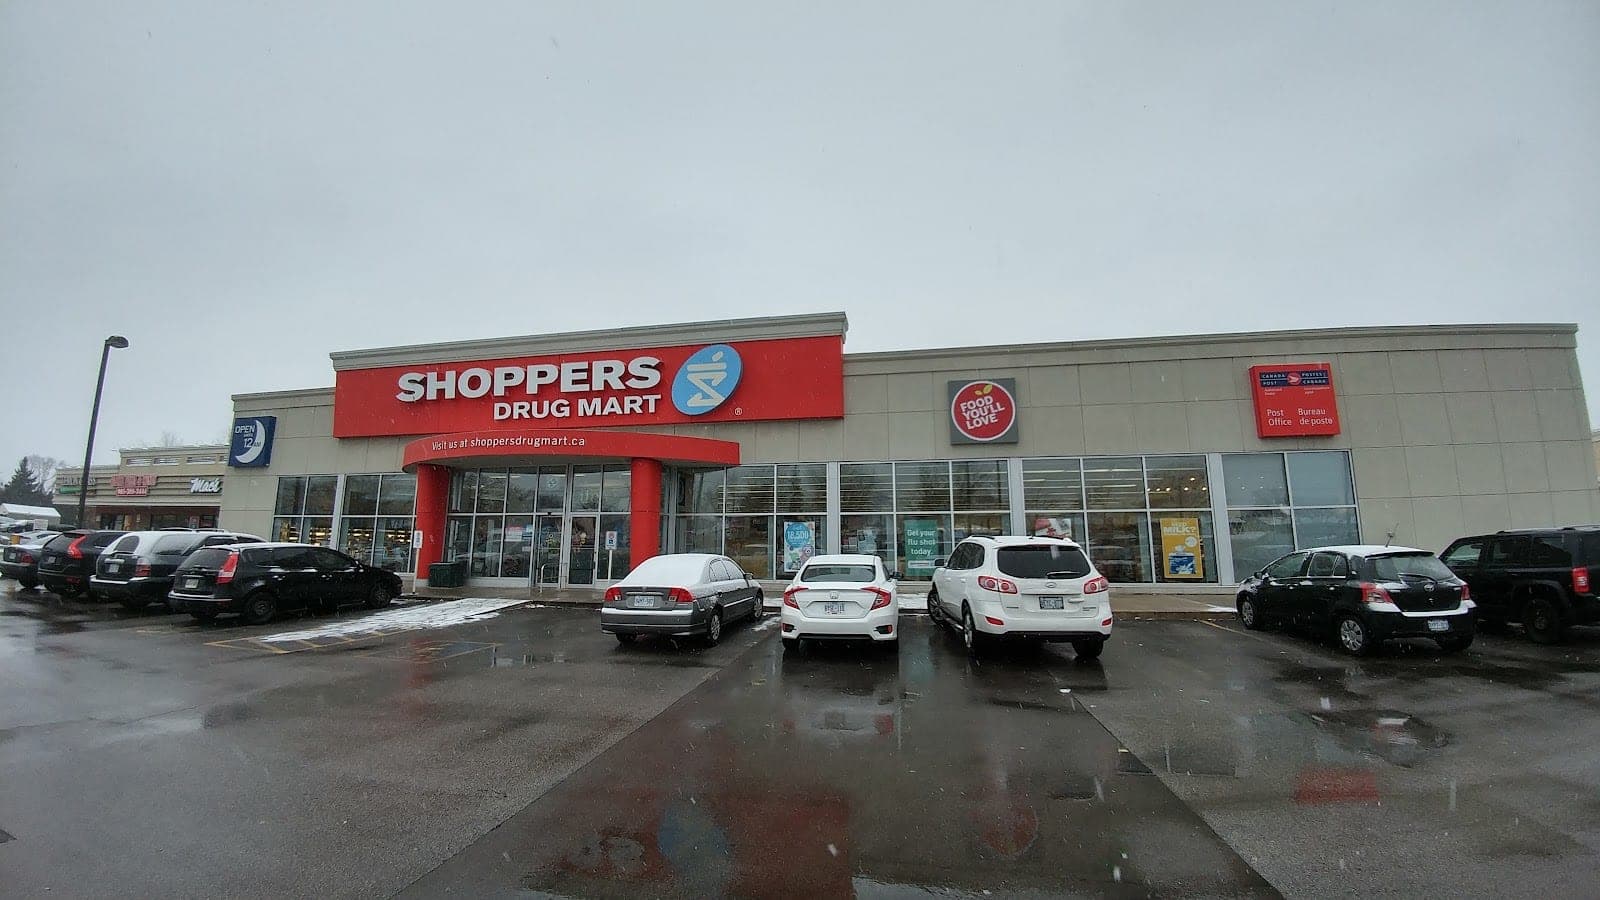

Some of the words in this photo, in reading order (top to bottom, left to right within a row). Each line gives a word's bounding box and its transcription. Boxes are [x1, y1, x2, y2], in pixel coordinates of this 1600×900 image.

[396, 356, 661, 402] SHOPPERS
[493, 398, 570, 420] DRUG
[577, 394, 661, 418] MART
[960, 395, 993, 412] FOOD
[961, 402, 1005, 420] YOU'LL
[1266, 409, 1284, 417] Post
[1297, 408, 1326, 416] Bureau
[966, 413, 999, 430] LOVE
[1268, 418, 1292, 426] Office
[1311, 417, 1333, 426] poste
[234, 425, 255, 434] OPEN
[432, 441, 447, 450] Visit
[449, 441, 458, 449] us
[460, 440, 468, 448] at
[470, 435, 585, 448] shoppersdrugmart.ca
[190, 478, 221, 493] Mac's
[907, 529, 919, 537] Get
[920, 530, 936, 538] your
[907, 538, 918, 546] flu
[920, 538, 936, 546] shot
